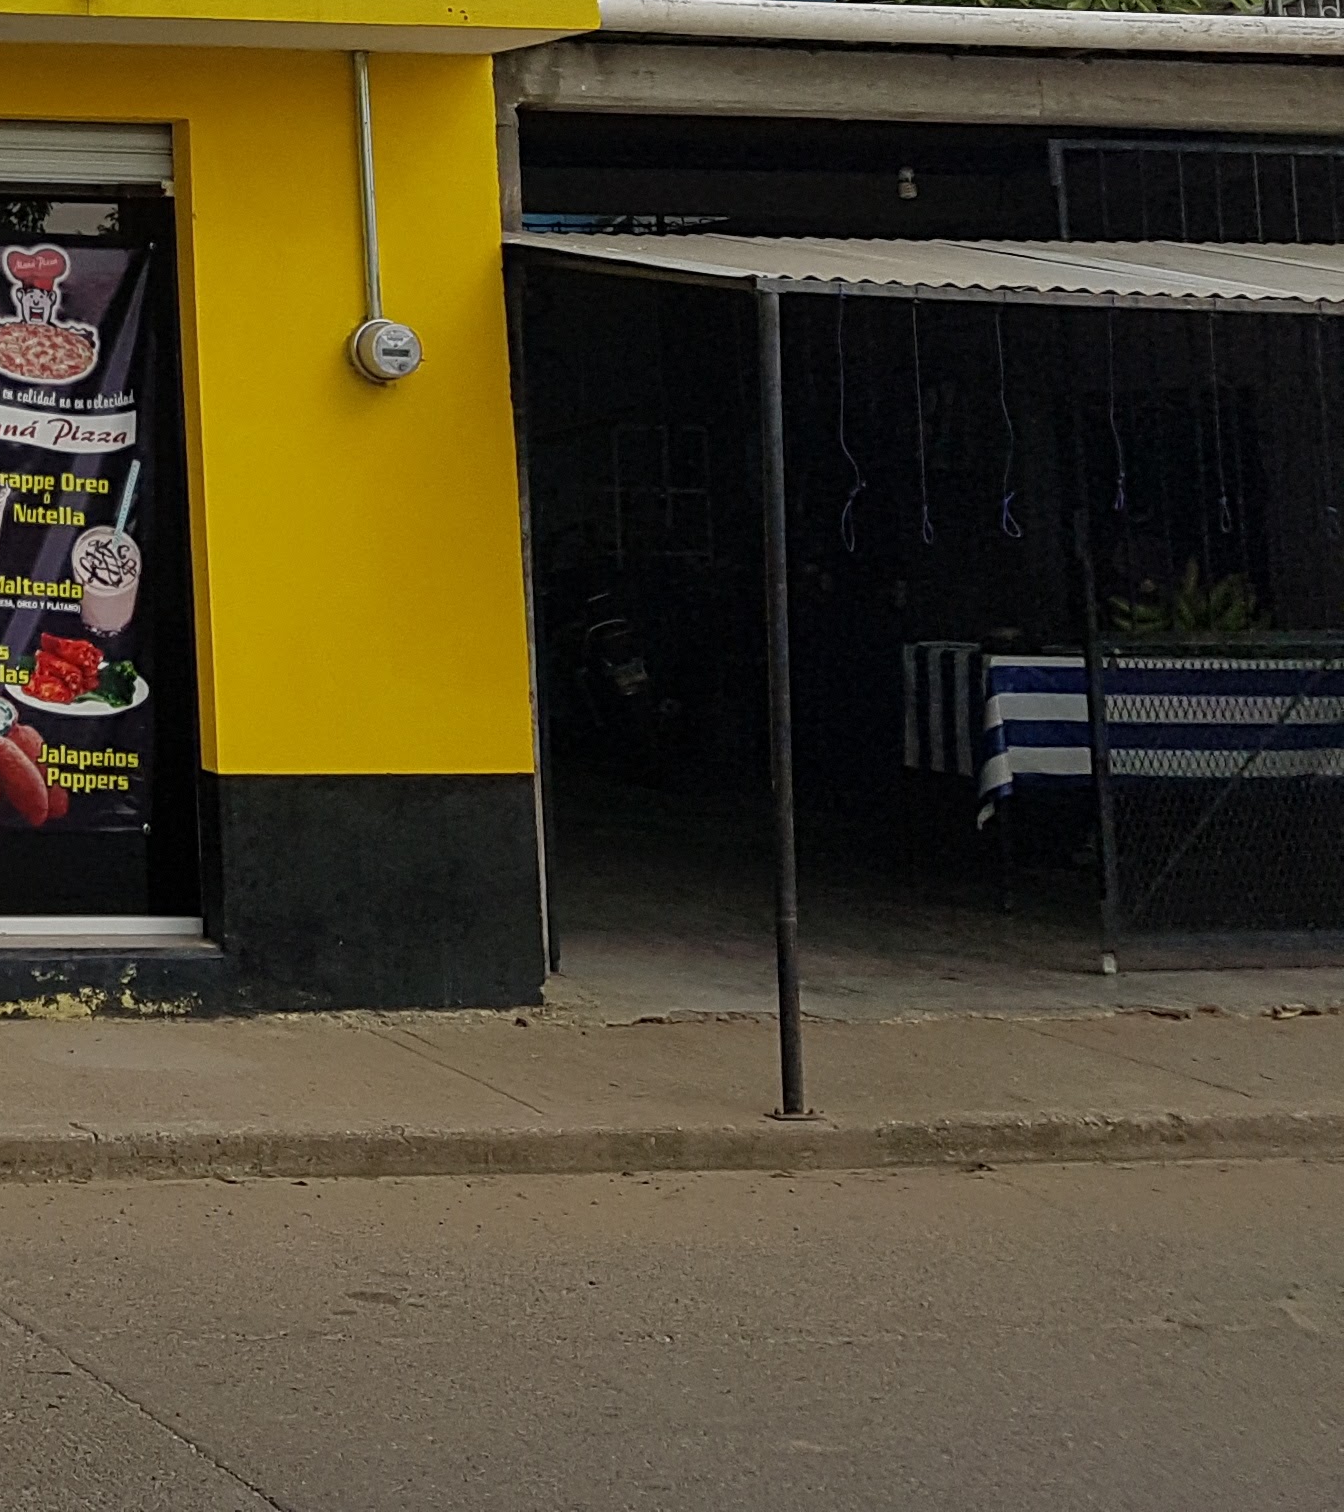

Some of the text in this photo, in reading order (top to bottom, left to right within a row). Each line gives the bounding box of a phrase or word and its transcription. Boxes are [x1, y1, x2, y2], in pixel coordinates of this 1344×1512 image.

[46, 417, 128, 447] Pizza
[60, 472, 110, 496] Oreo
[12, 503, 87, 527] Nutella
[37, 743, 140, 769] Jalapeños
[45, 767, 130, 793] Poppers
